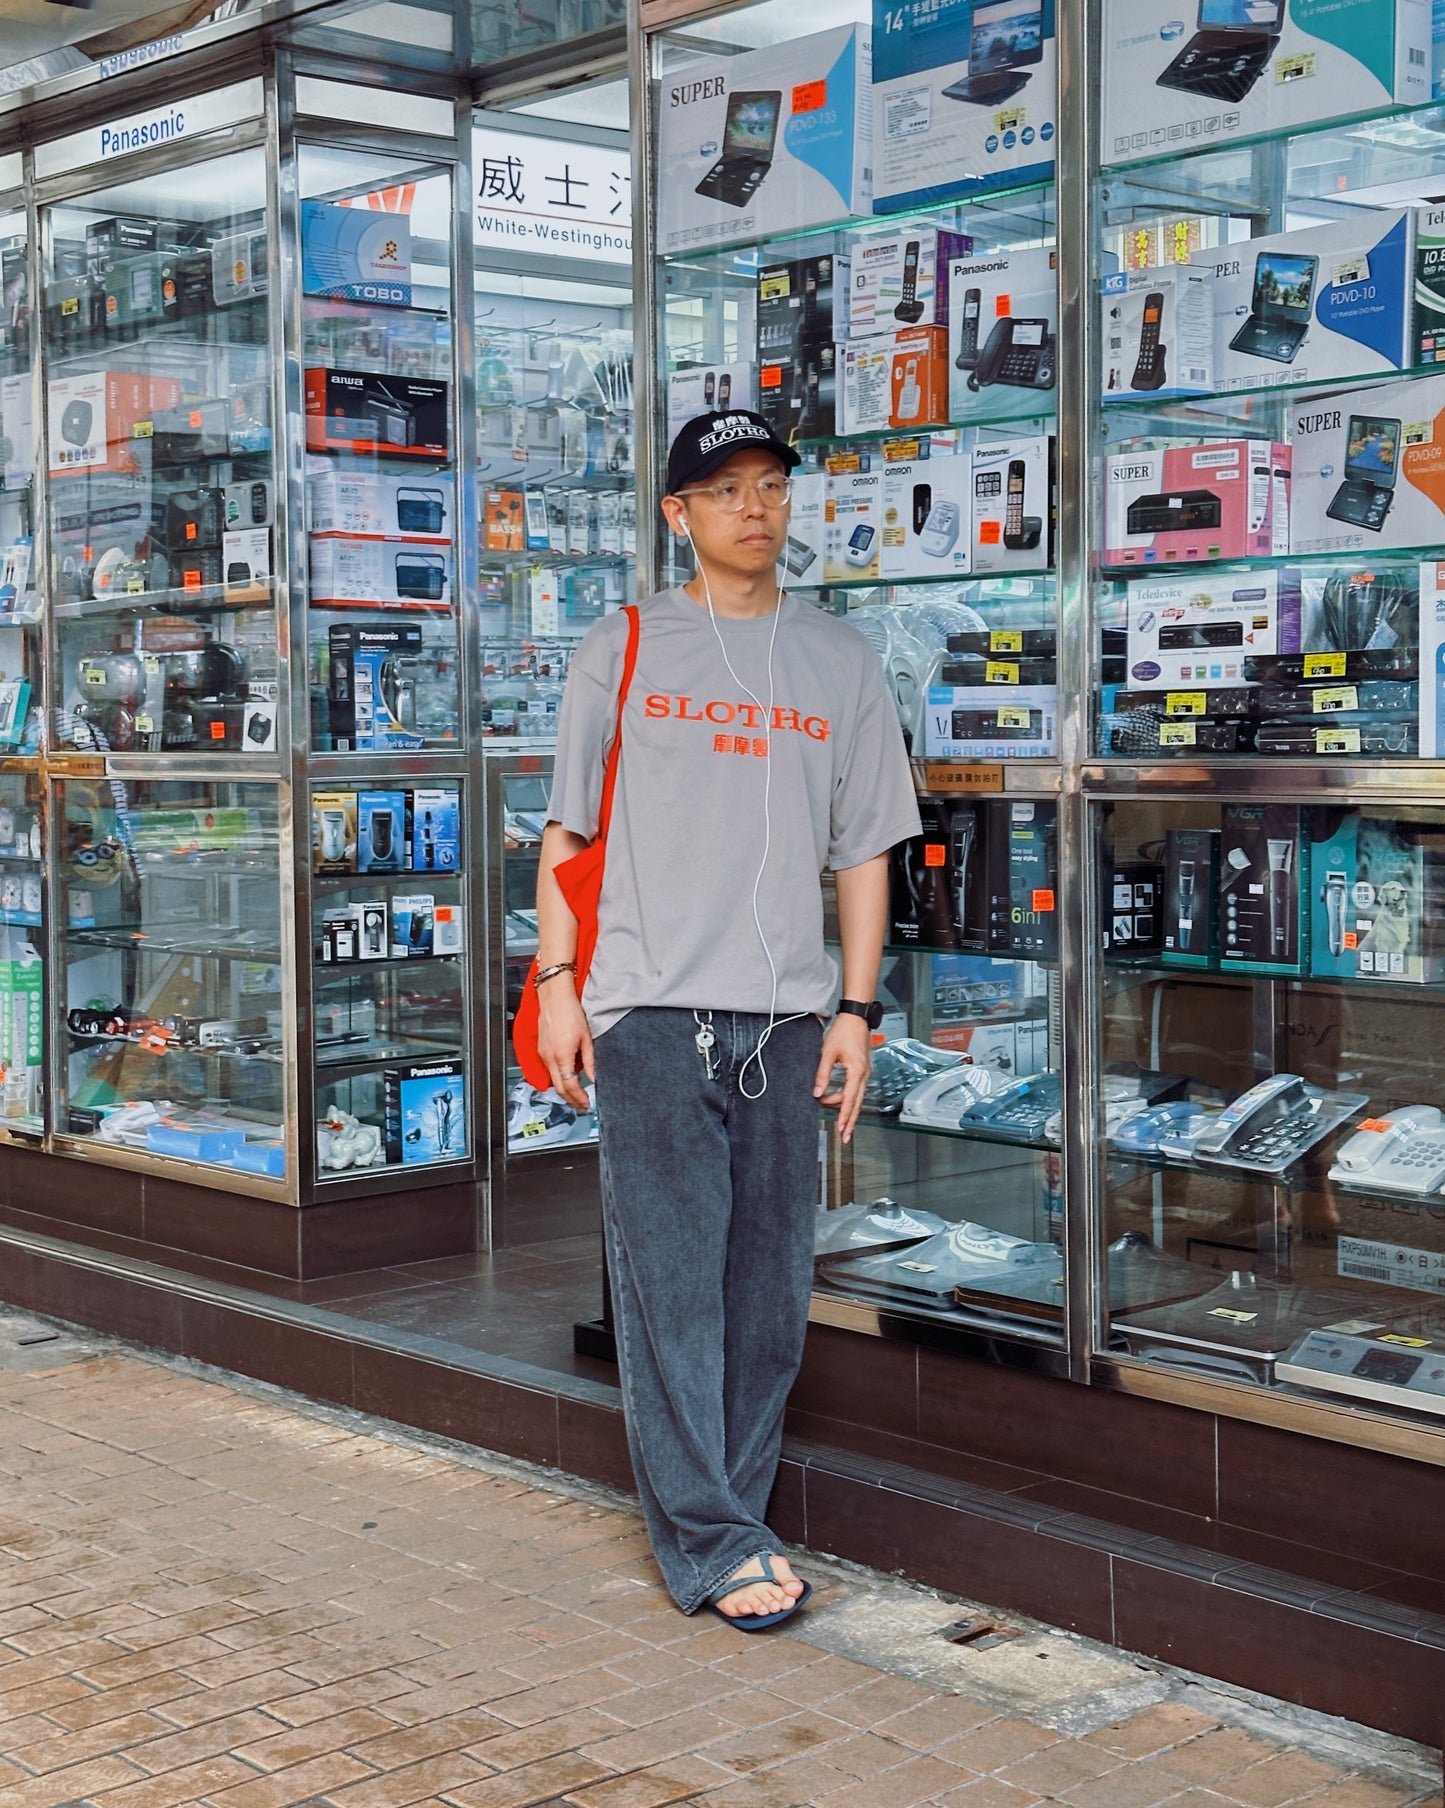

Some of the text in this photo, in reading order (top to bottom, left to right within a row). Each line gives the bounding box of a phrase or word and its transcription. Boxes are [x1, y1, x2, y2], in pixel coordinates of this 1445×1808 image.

[671, 76, 726, 108] SUPER
[789, 110, 837, 133] PDVD-133
[102, 110, 184, 155] Panasonic
[954, 259, 1009, 276] Panasonic
[1216, 261, 1240, 278] PER
[760, 269, 789, 280] Panasonic
[352, 285, 404, 301] TOBO
[1331, 286, 1376, 305] PDVD-10
[761, 356, 791, 366] Panasonic
[331, 375, 364, 386] aiwa
[1298, 411, 1341, 435] SUPER
[976, 448, 1010, 458] Panasonic
[885, 466, 912, 476] OMRON
[1113, 465, 1149, 481] SUPER
[852, 477, 878, 486] OMRON
[490, 524, 522, 534] BASS+
[1136, 589, 1182, 600] Teledevice
[360, 632, 399, 640] Panasonic
[644, 693, 832, 742] SLOTHG
[1227, 807, 1265, 819] VGR
[1176, 836, 1199, 846] VGR
[410, 1065, 453, 1077] Panasonic
